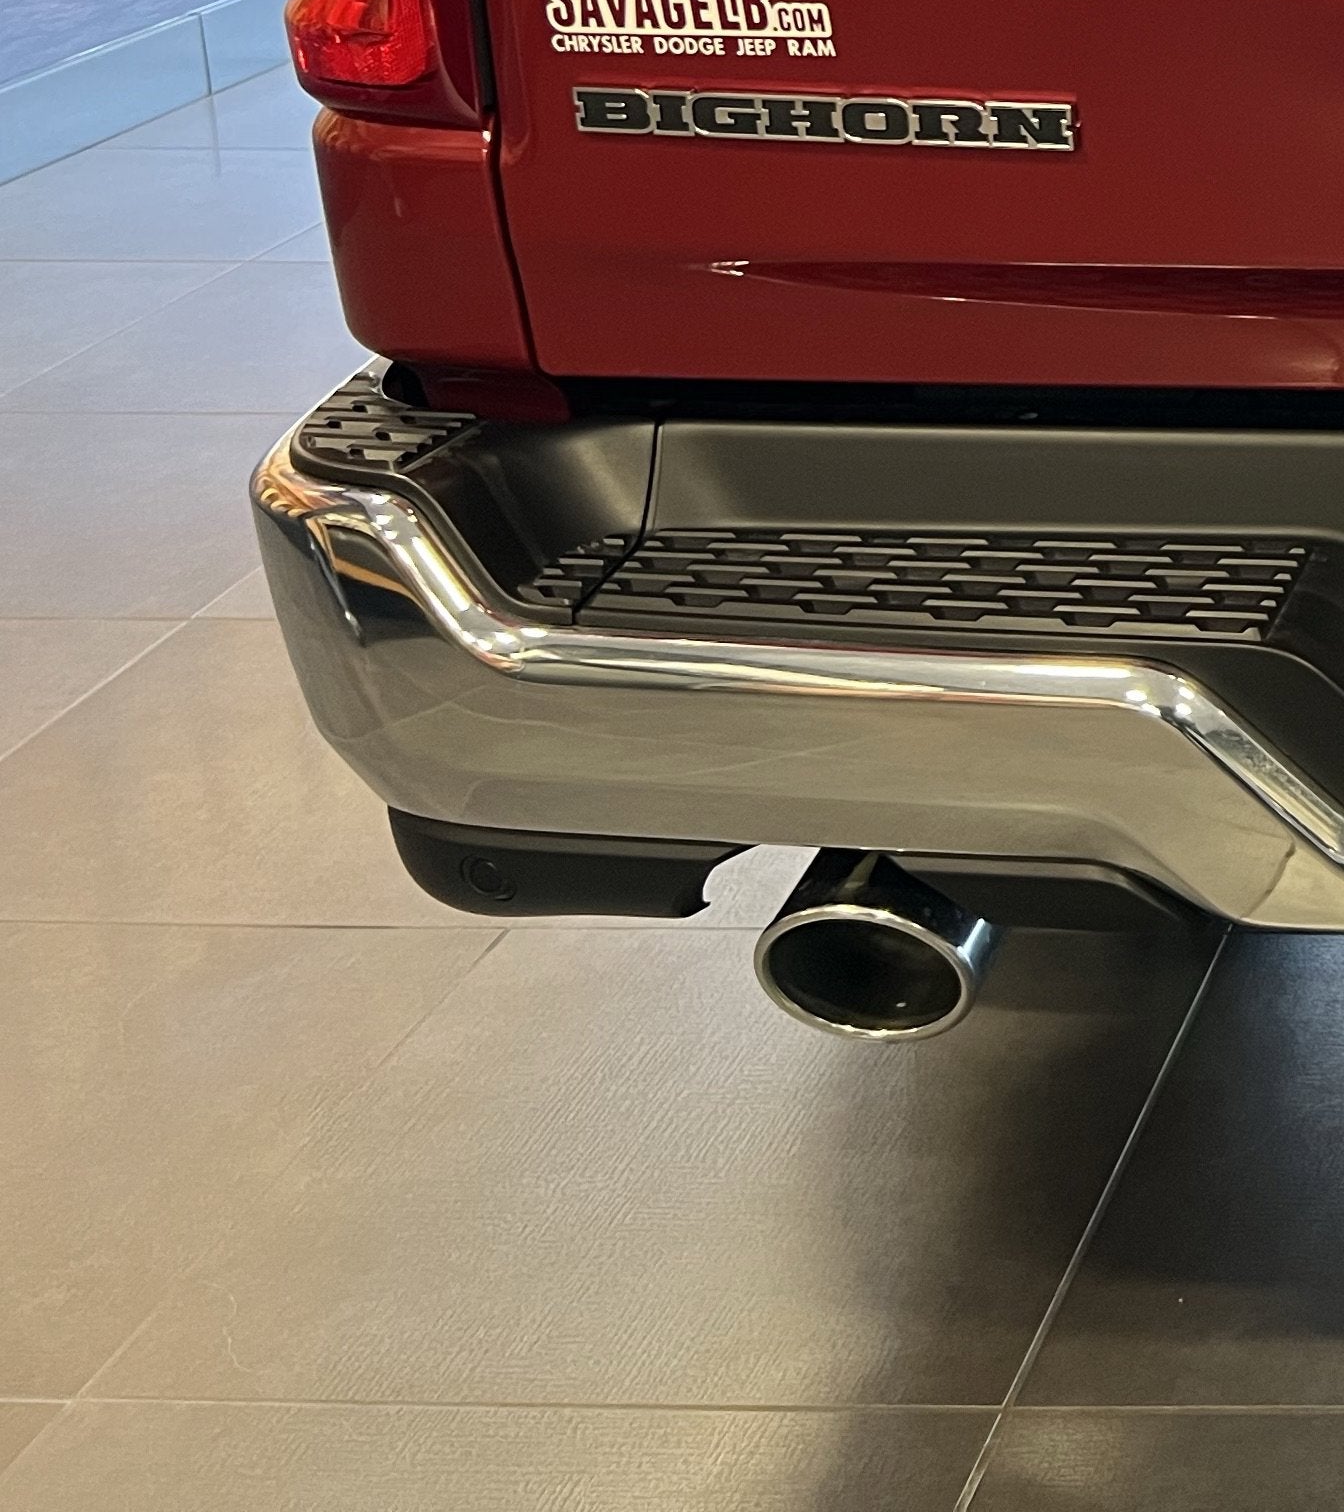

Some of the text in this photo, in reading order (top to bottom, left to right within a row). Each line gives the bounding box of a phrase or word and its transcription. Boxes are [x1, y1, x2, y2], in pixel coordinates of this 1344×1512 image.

[551, 34, 837, 57] CHRYSLER DODGE JEEP RAM
[572, 86, 1080, 152] BIGHORN
